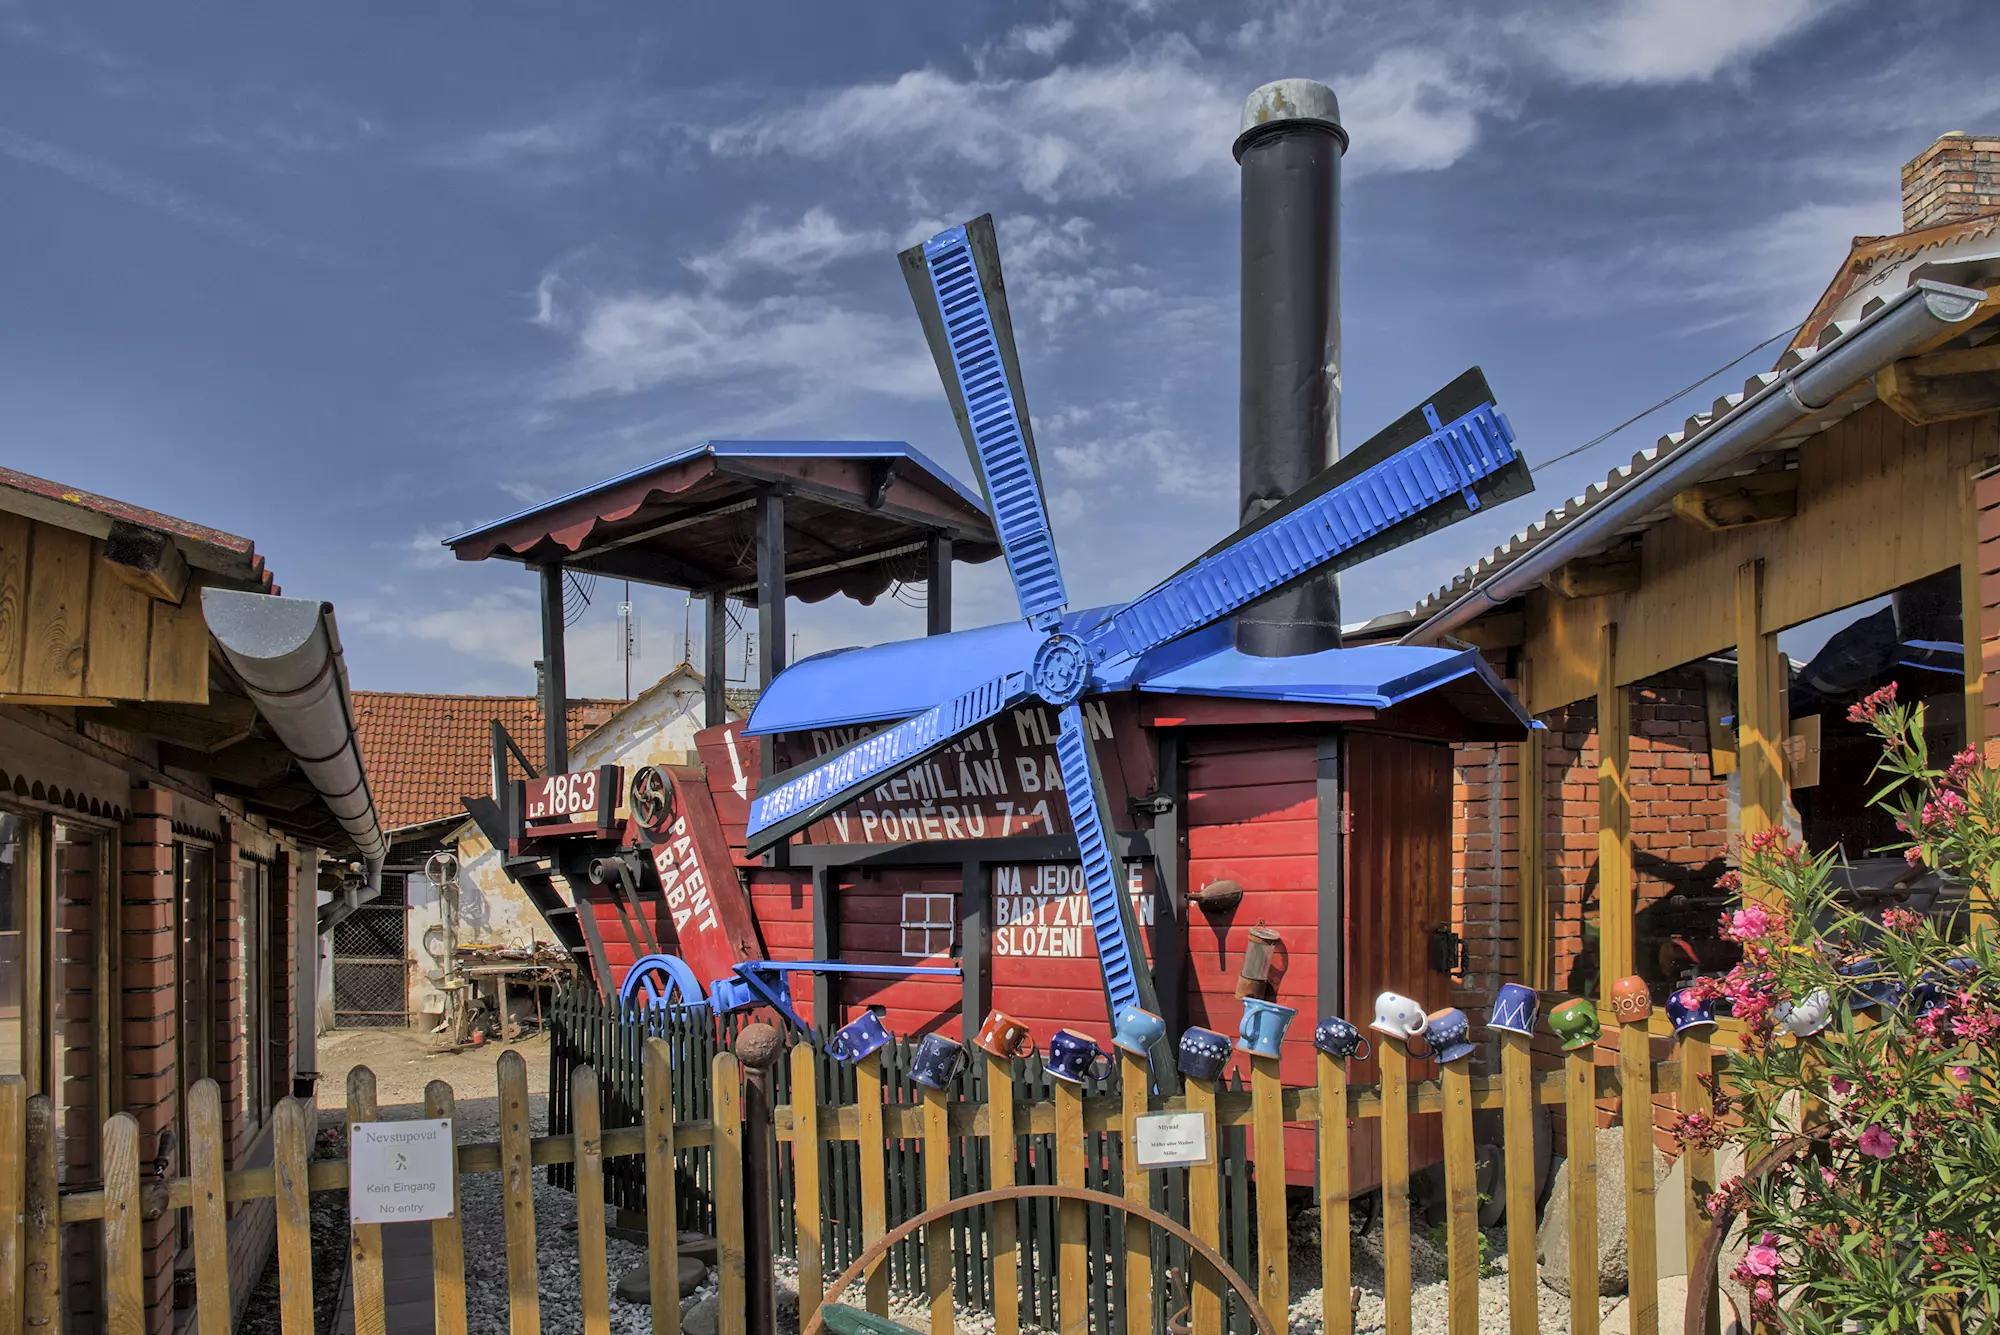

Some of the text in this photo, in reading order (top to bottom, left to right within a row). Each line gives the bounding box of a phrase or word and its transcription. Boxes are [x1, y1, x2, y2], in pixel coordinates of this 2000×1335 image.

[1014, 701, 1114, 748] MLN
[529, 771, 597, 819] L.P. 1863
[832, 799, 1055, 843] V POMĚRU 7:1
[655, 846, 695, 932] BABA
[668, 815, 719, 932] PATENT
[996, 866, 1023, 896] NA
[996, 895, 1049, 926] BABY
[996, 921, 1083, 957] SLOŽENÍ
[366, 1182, 436, 1194] Kein Eingang
[379, 1203, 425, 1213] No entry
